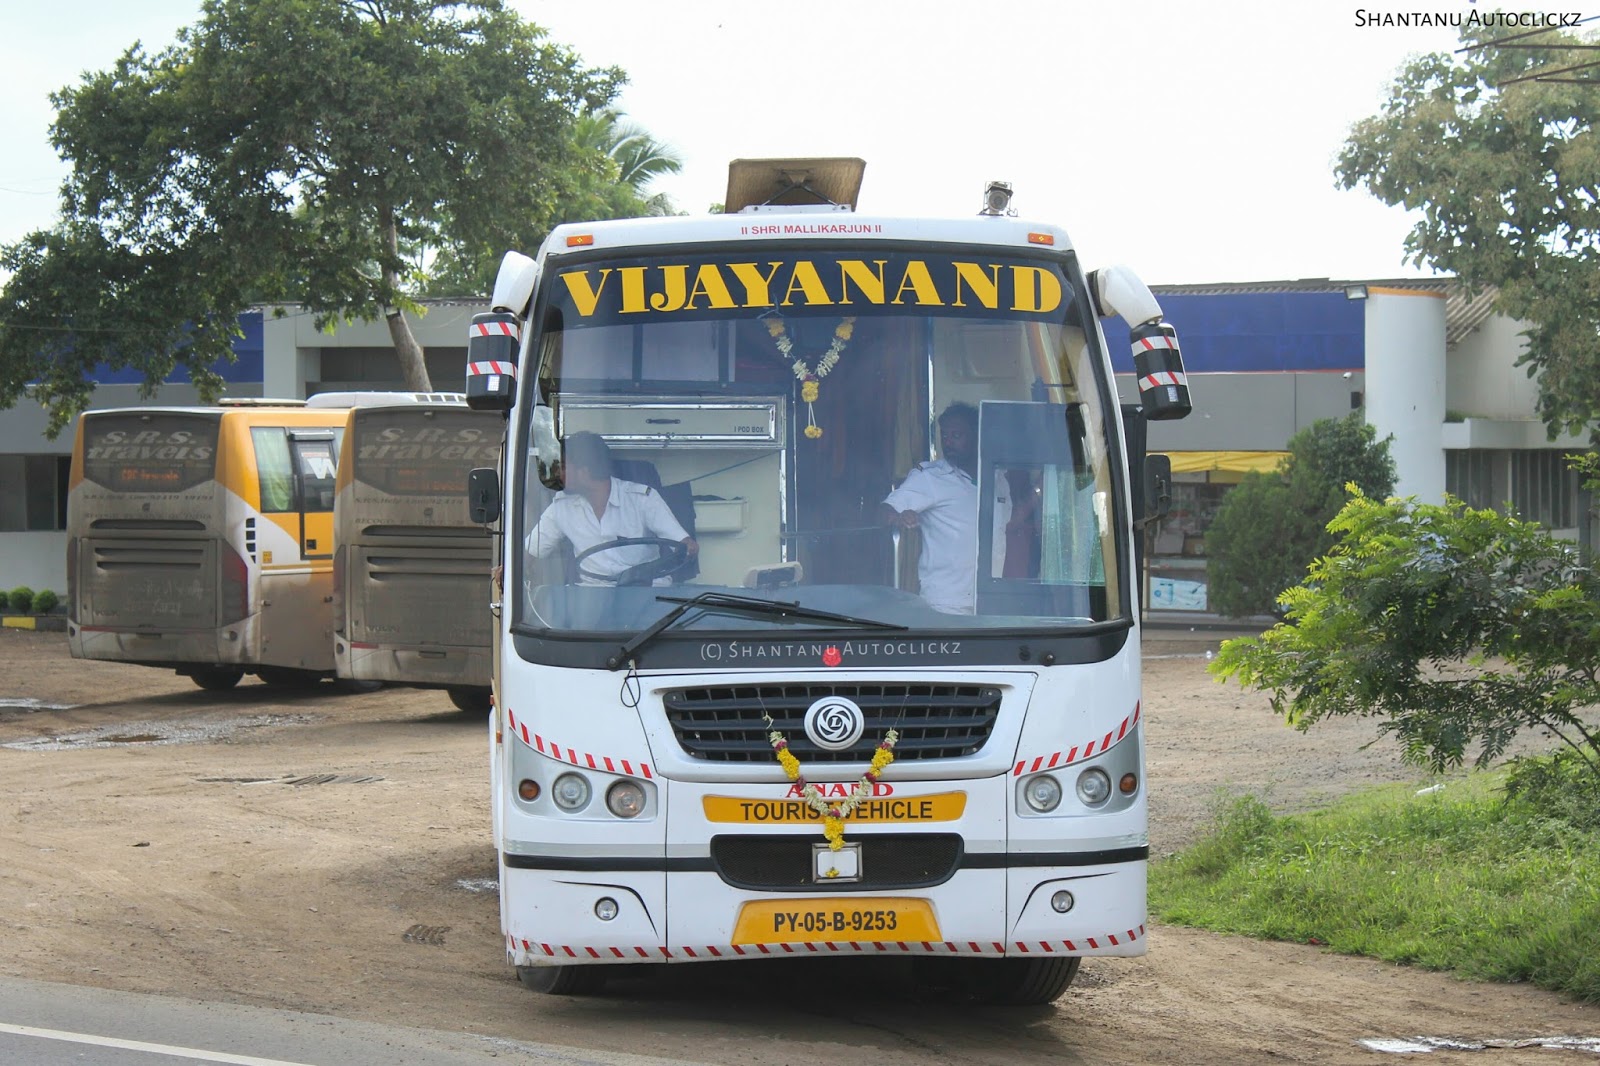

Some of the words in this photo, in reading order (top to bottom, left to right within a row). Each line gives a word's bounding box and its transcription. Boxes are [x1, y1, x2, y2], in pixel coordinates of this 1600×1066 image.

[751, 225, 781, 235] SHRI
[784, 224, 872, 234] MALLIKARJUN
[559, 259, 1063, 317] VIJAYANAND
[774, 910, 898, 933] PY-05-B-9253
